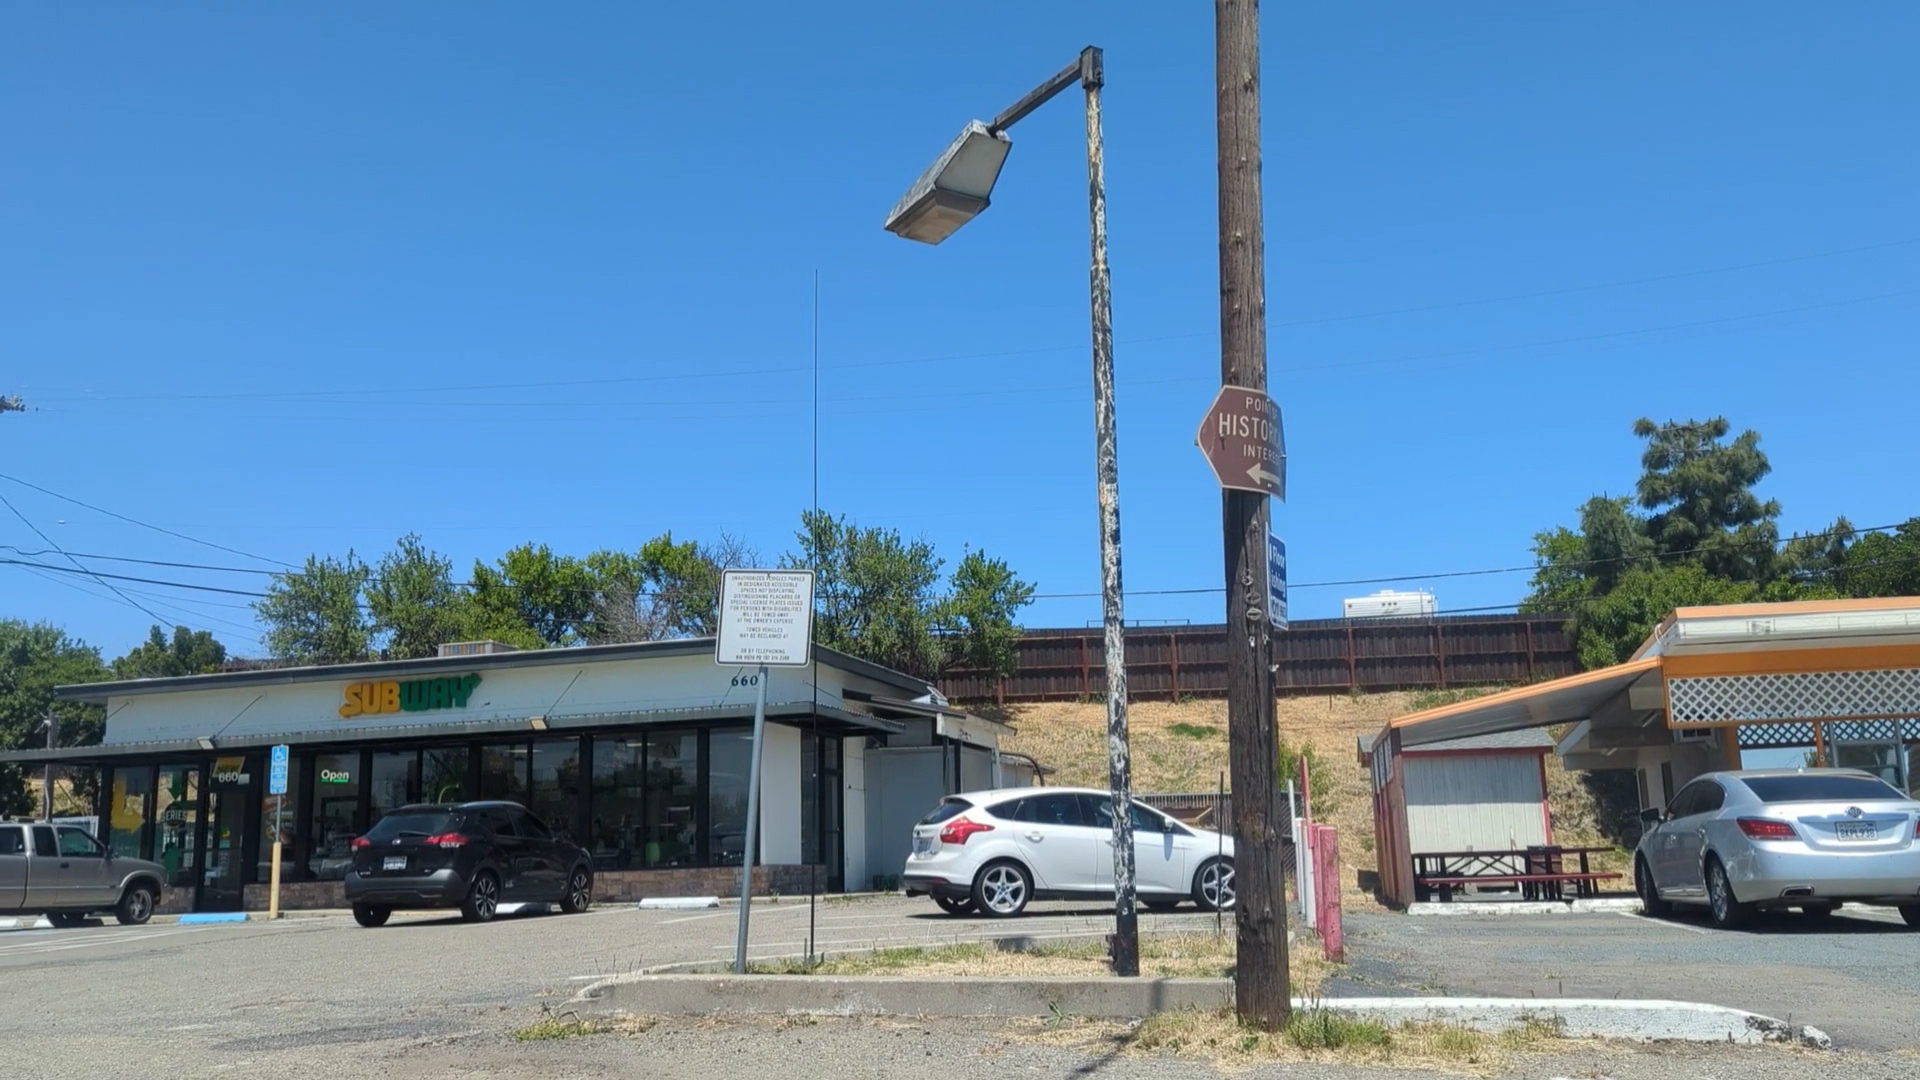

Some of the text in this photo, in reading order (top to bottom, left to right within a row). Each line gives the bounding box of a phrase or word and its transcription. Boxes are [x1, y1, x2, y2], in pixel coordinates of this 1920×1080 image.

[1246, 396, 1271, 416] POINT
[731, 675, 758, 687] 660
[338, 672, 482, 718] SUBWAY
[218, 772, 238, 782] 660
[321, 769, 349, 782] Open
